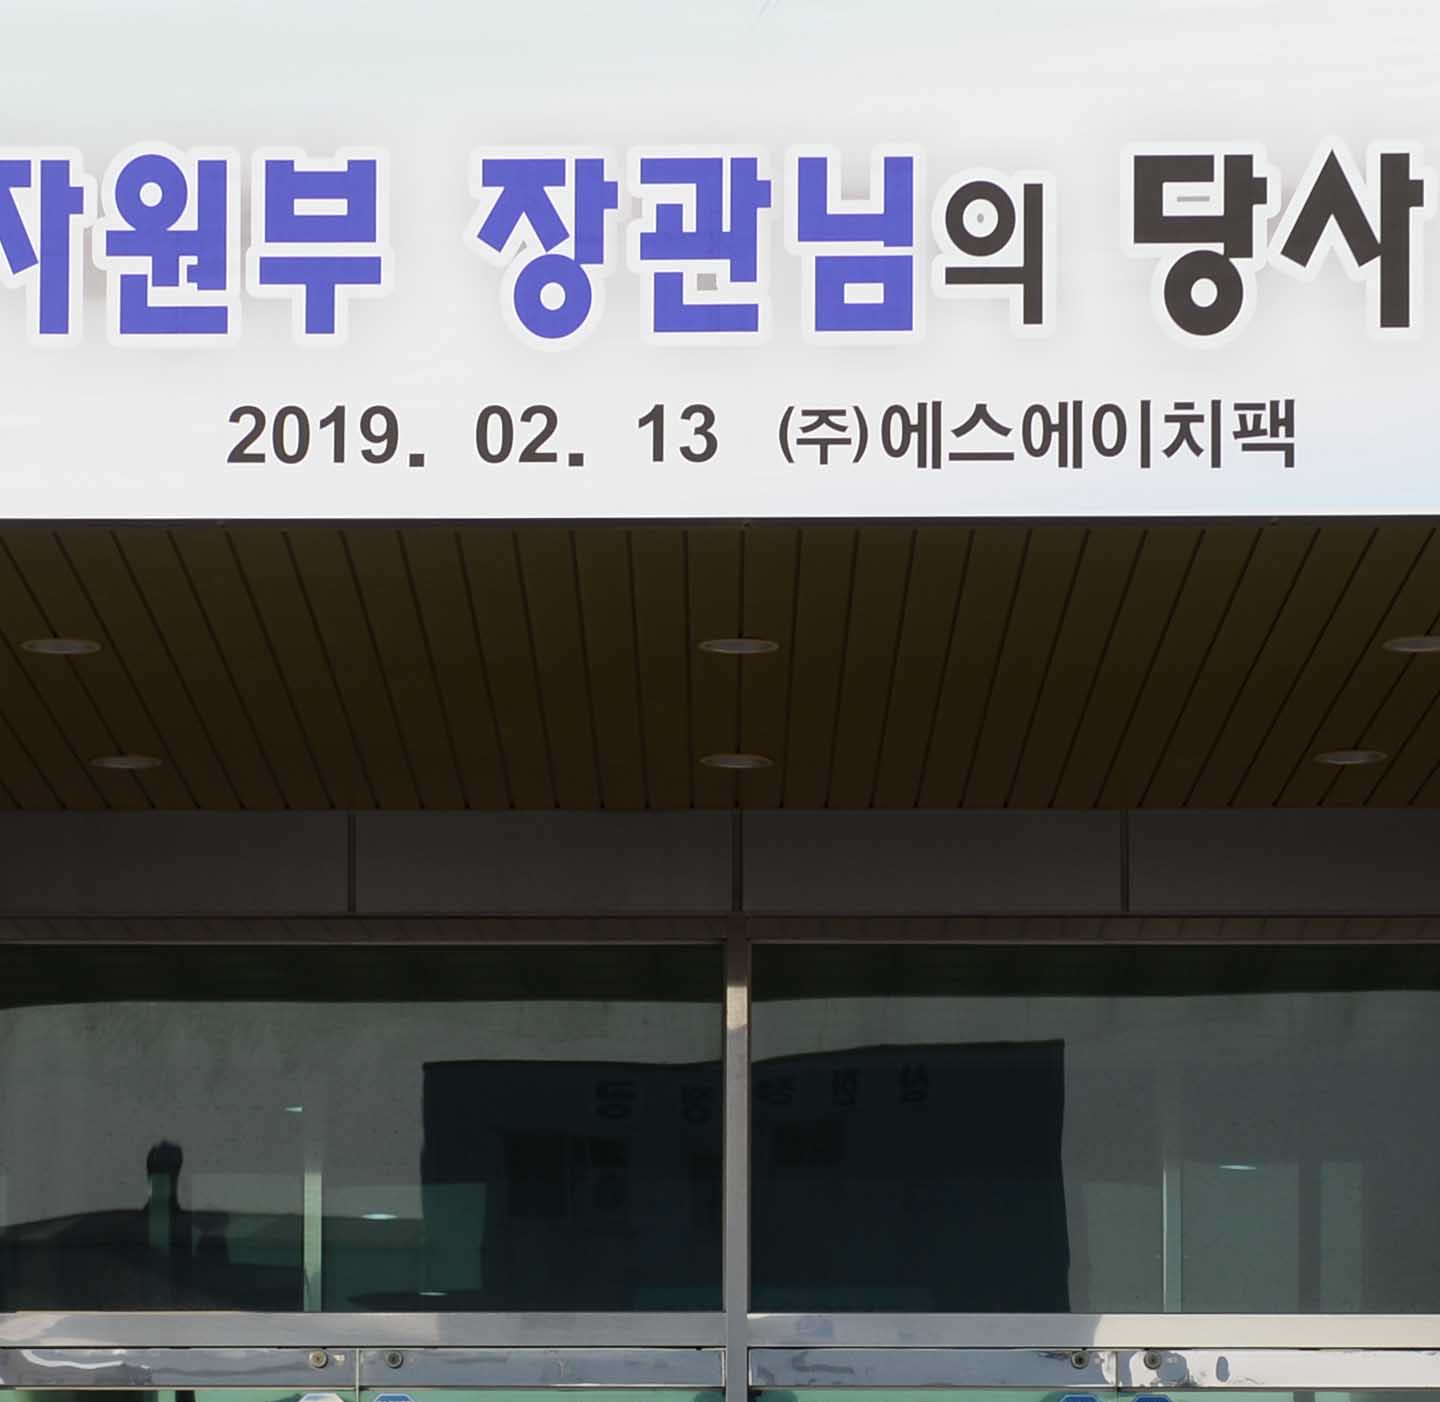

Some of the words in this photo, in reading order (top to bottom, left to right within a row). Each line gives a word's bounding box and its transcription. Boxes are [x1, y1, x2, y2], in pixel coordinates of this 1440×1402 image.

[478, 155, 1044, 340] 장관님의
[1132, 150, 1425, 337] 당사
[227, 405, 426, 468] 2019.
[475, 405, 585, 468] 02.
[637, 404, 719, 464] 13
